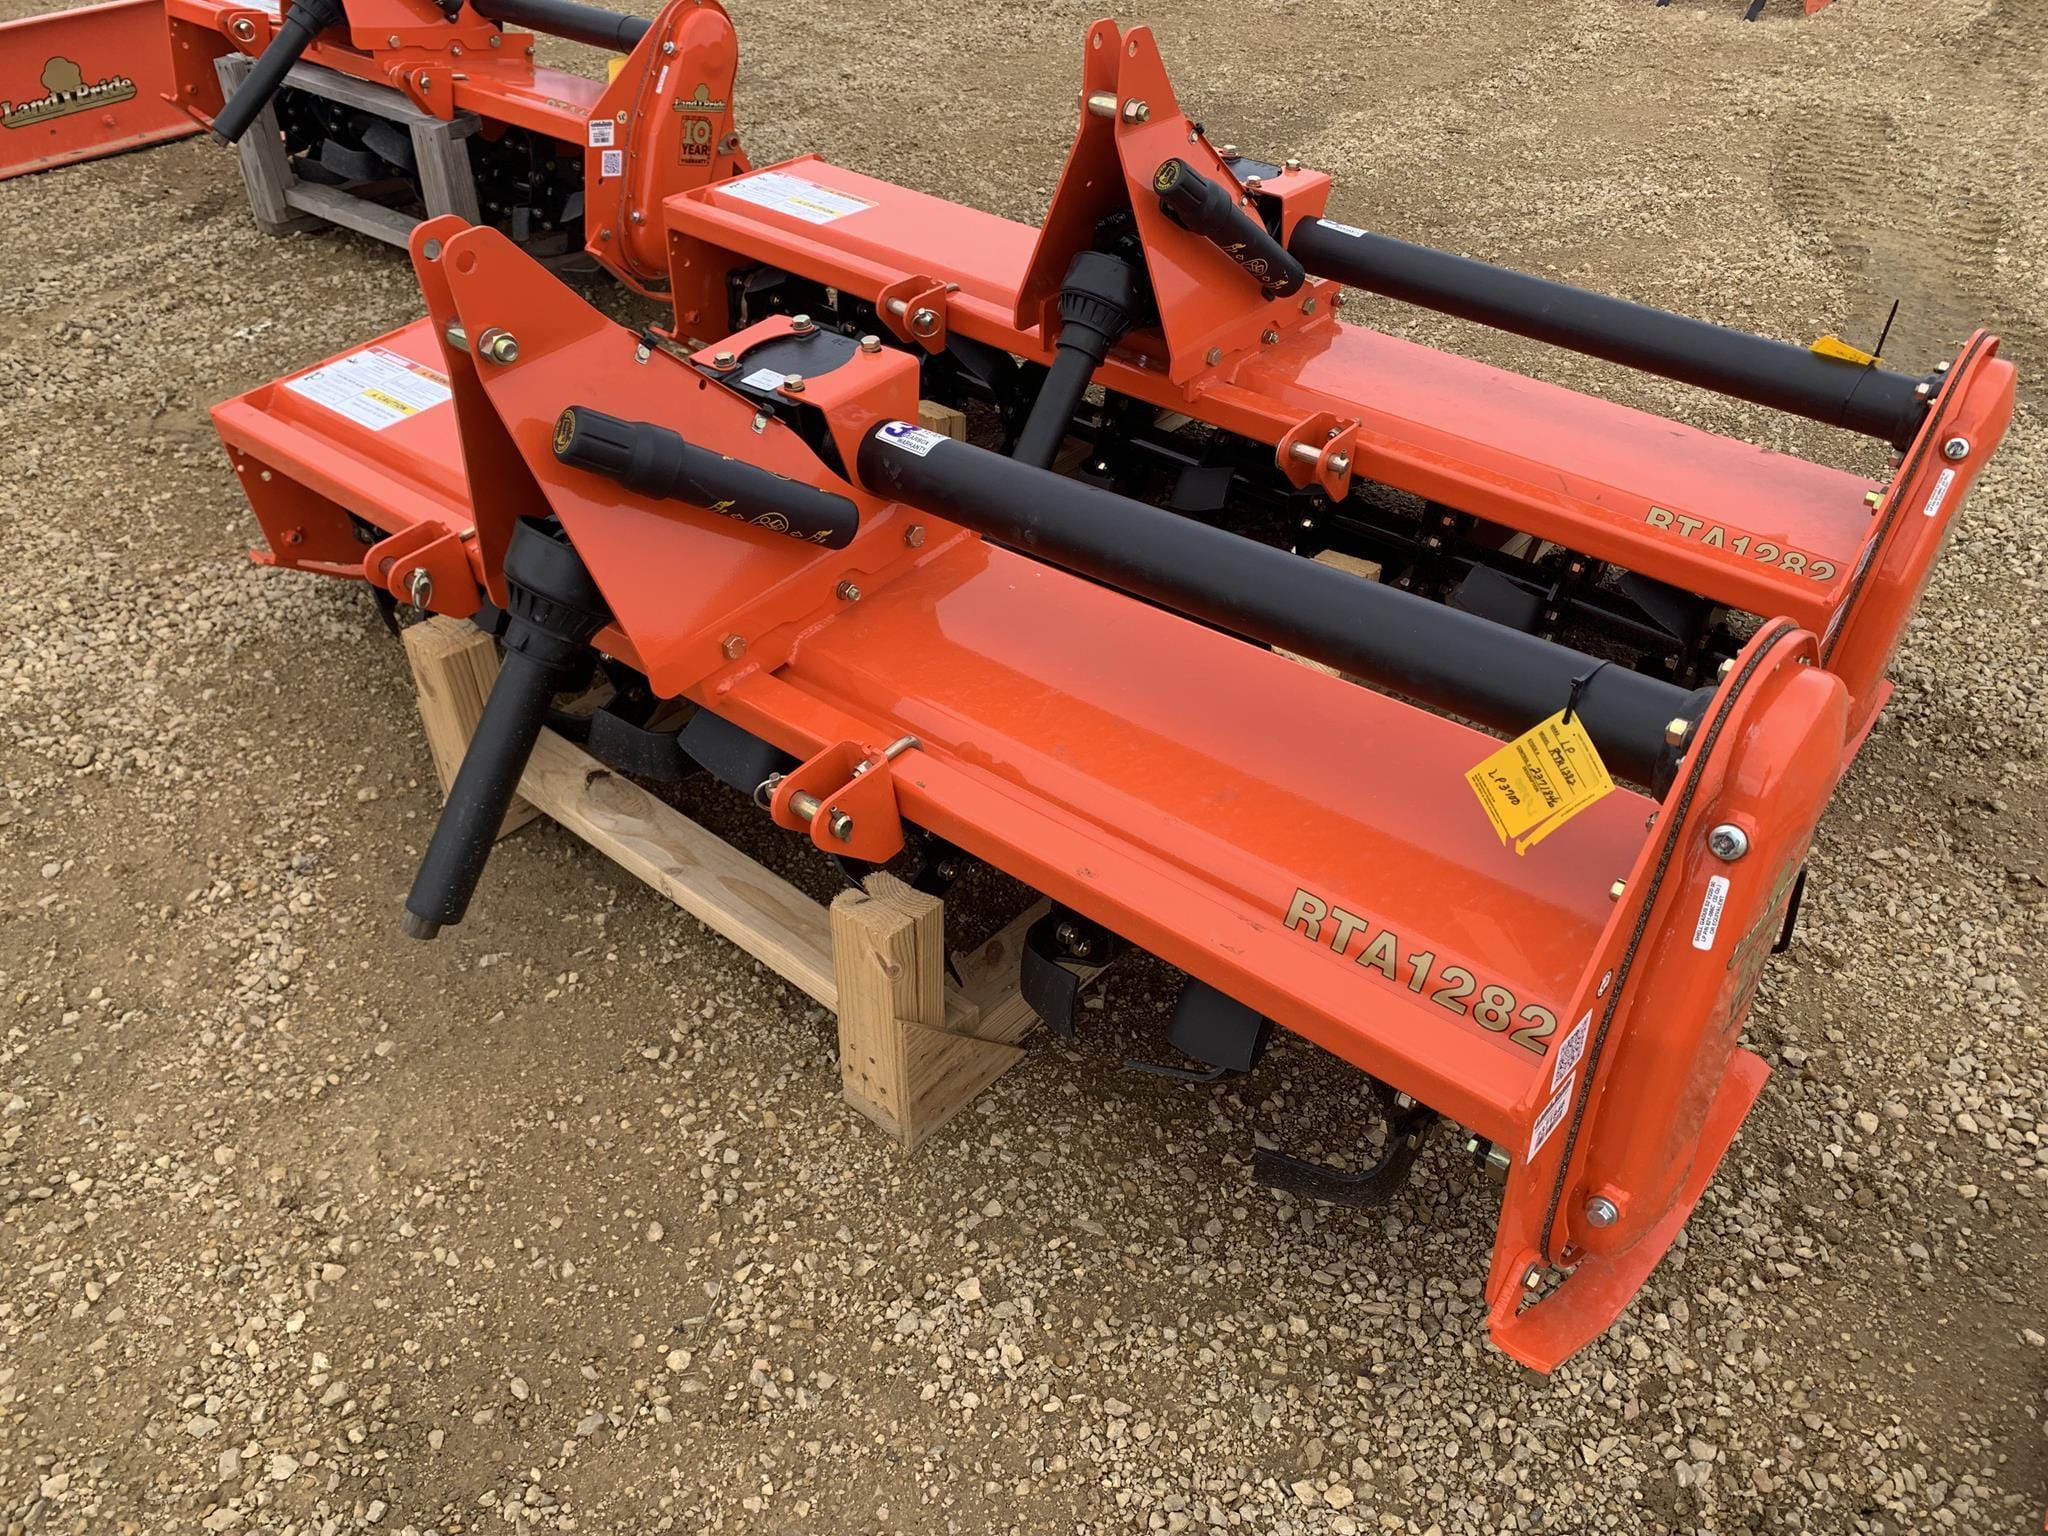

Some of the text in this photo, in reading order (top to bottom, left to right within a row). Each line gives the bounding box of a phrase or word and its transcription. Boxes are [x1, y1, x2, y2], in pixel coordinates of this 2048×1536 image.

[1, 75, 133, 119] Land Pride
[682, 119, 712, 145] 10
[682, 143, 709, 156] YEAR
[896, 438, 927, 452] WARRANTY
[1712, 895, 1724, 926] EQUIVALENT
[1283, 887, 1558, 1056] RTA1282
